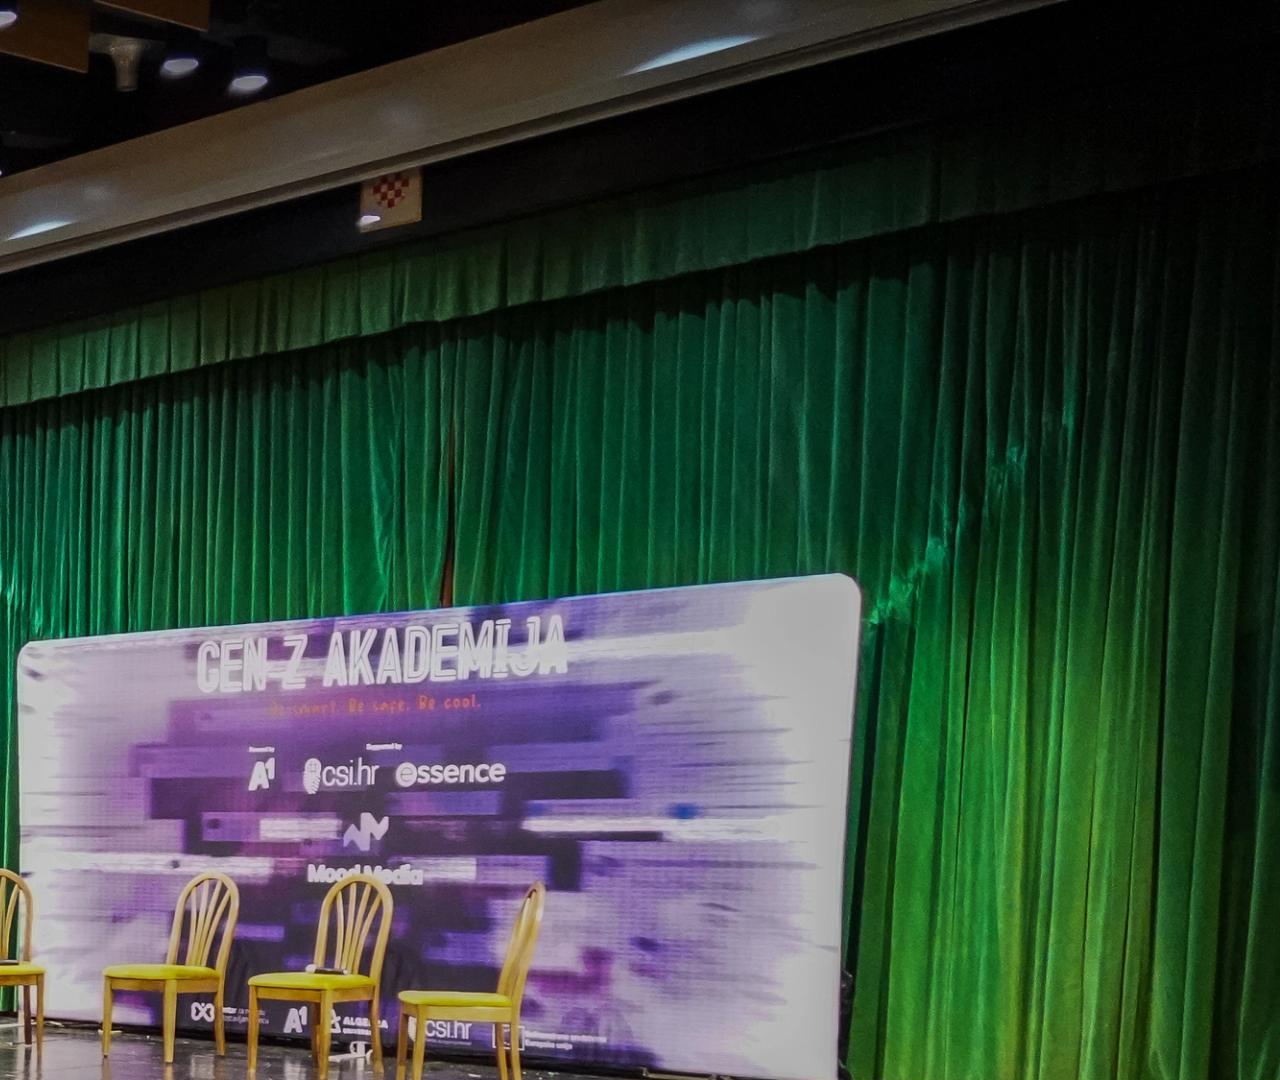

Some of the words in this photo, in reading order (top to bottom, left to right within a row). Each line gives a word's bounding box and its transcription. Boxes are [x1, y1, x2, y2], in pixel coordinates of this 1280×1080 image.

[197, 637, 268, 693] GEN
[282, 633, 308, 690] Z
[323, 615, 569, 687] AKADEMIJA
[418, 695, 436, 711] Be
[444, 694, 481, 709] cool.
[248, 757, 275, 791] A1
[323, 757, 379, 786] csi.hr
[396, 762, 506, 788] essence
[283, 1006, 308, 1033] A1
